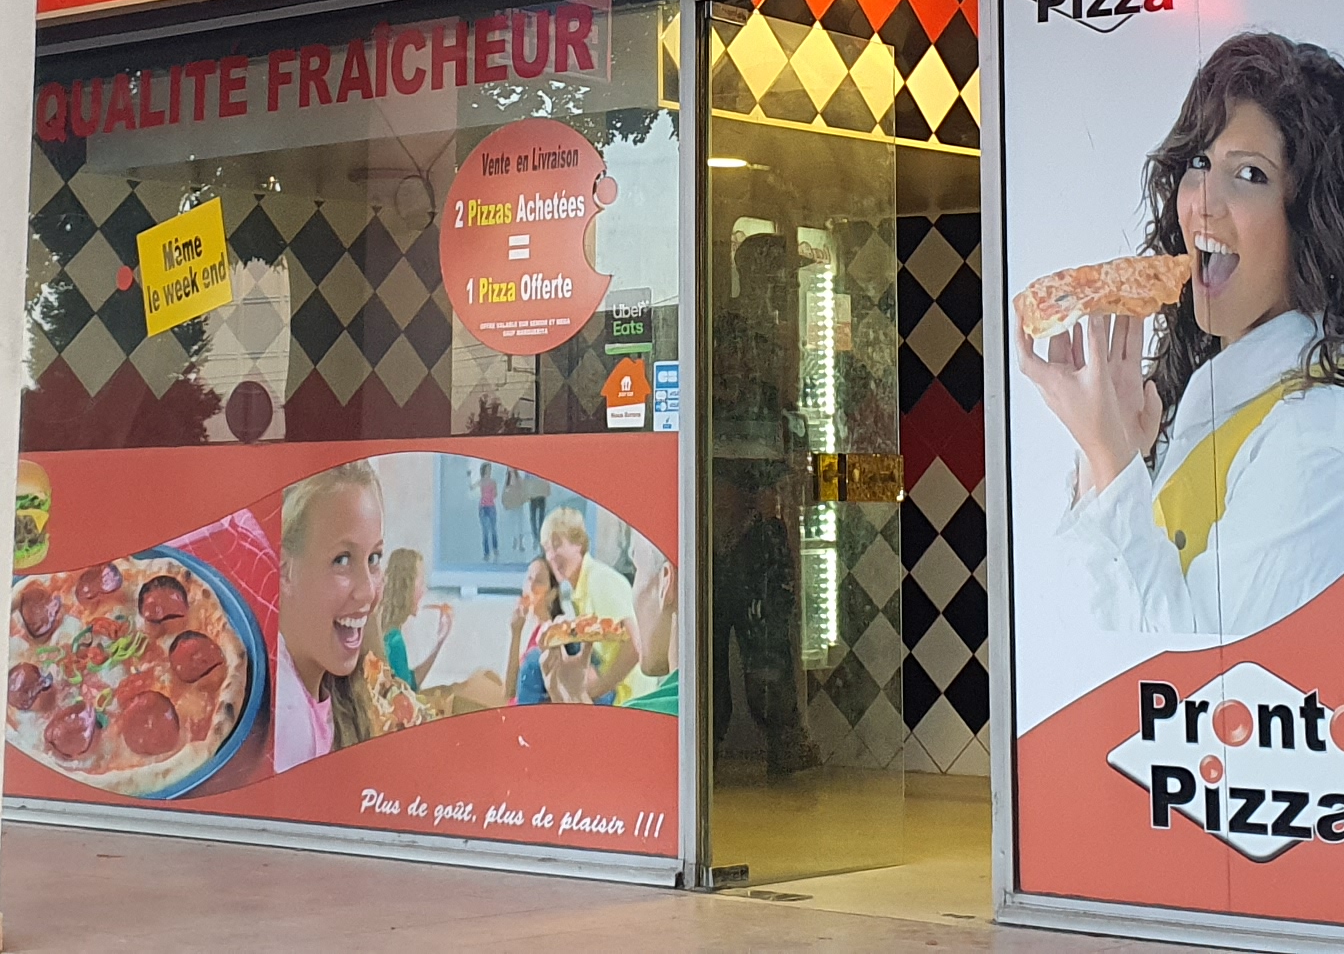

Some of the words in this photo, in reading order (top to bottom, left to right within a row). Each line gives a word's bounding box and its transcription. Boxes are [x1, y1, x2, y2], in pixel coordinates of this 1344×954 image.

[36, 42, 249, 143] QUALITÉ
[267, 1, 594, 111] FRAÎCHEUR
[482, 151, 510, 176] Vente
[517, 155, 529, 173] en
[532, 145, 579, 172] Livraison
[455, 201, 464, 228] 2
[467, 199, 512, 227] Pizzas
[516, 190, 585, 223] Achetées
[162, 236, 202, 271] Même
[147, 286, 160, 313] le
[163, 266, 199, 306] week
[202, 252, 227, 289] end
[466, 278, 474, 304] 1
[479, 277, 516, 304] Pizza
[520, 273, 573, 300] Offerte
[613, 303, 643, 319] Uber
[613, 321, 644, 336] Eats
[360, 788, 401, 814] Plus
[407, 796, 428, 817] de
[434, 802, 476, 825] goût,
[483, 802, 524, 829] plus
[531, 806, 554, 828] de
[558, 808, 626, 836] plaisir
